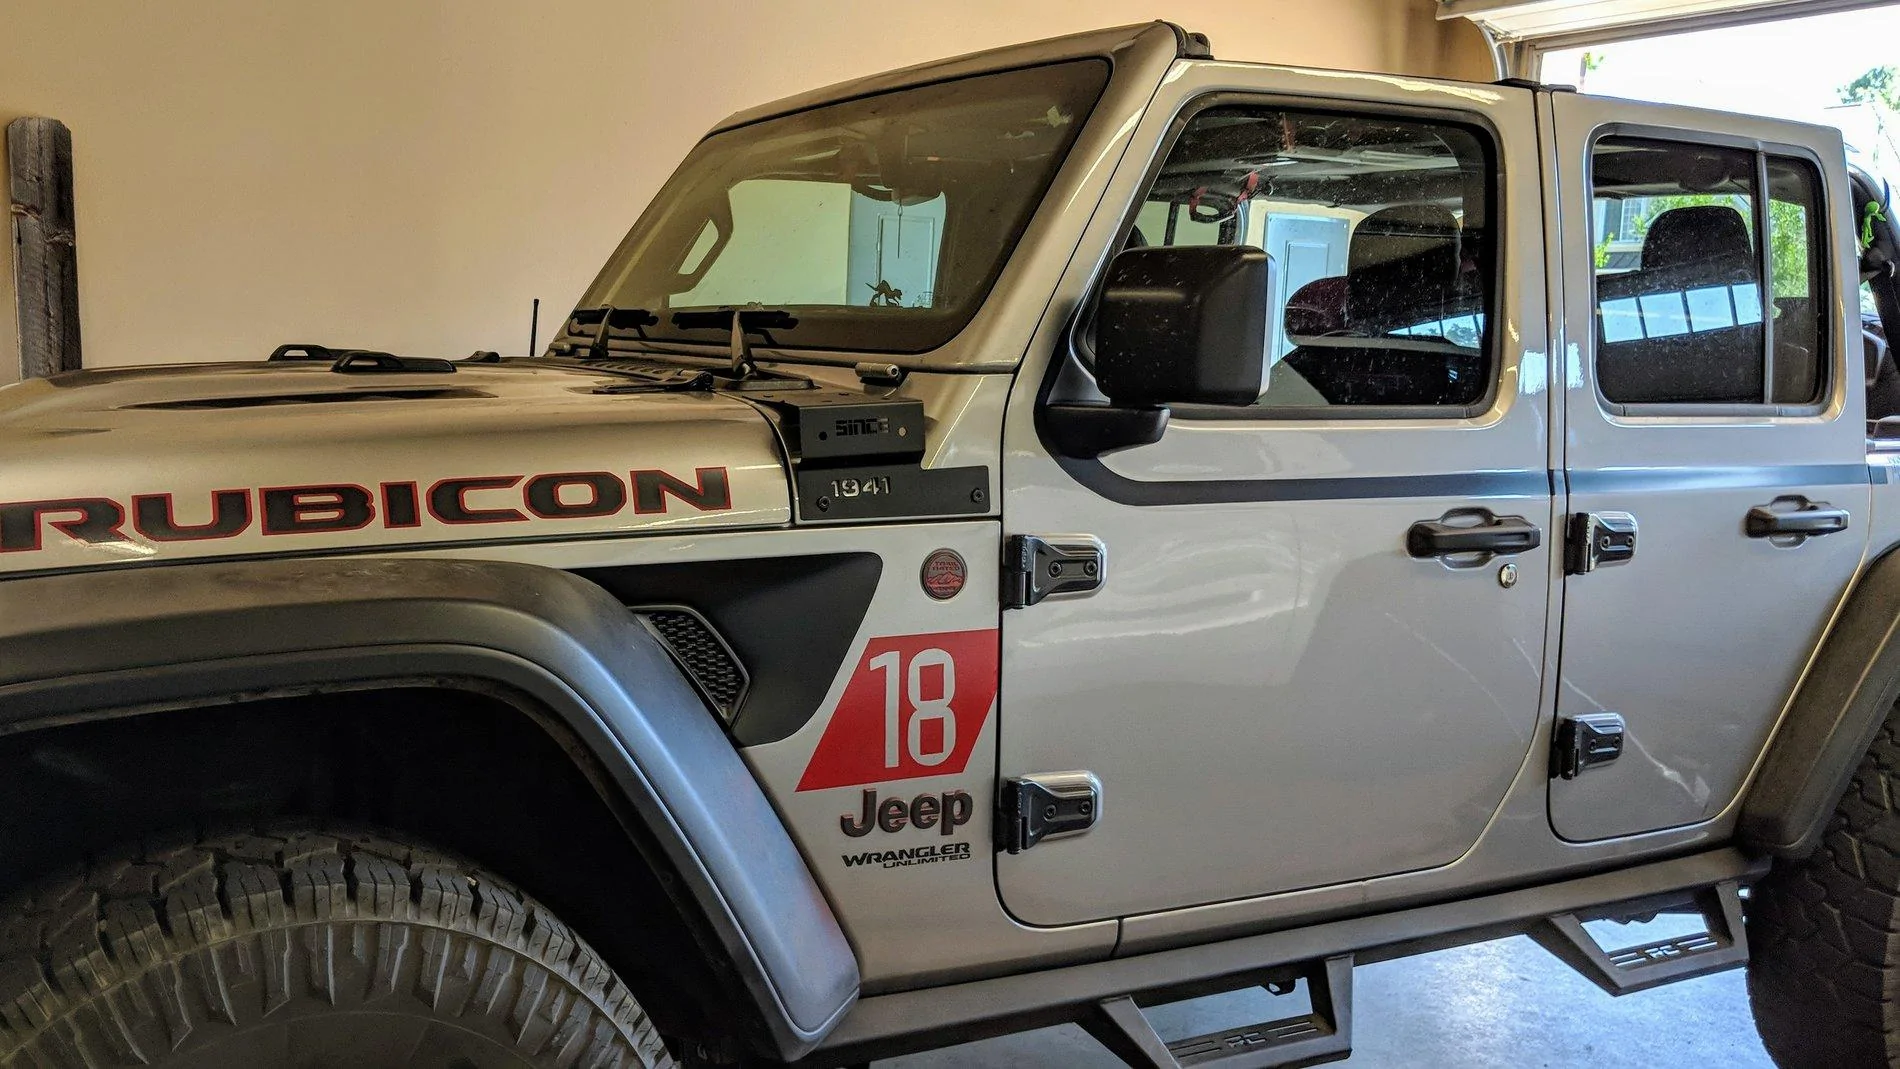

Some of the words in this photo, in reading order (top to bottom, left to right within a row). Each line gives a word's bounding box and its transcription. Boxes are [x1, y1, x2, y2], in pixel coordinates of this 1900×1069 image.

[831, 477, 890, 497] 1941
[0, 466, 732, 553] RUBICON
[869, 648, 956, 768] 18
[840, 788, 973, 837] Jeep
[842, 842, 970, 867] WRANGLER
[883, 853, 971, 868] UNLIMITED
